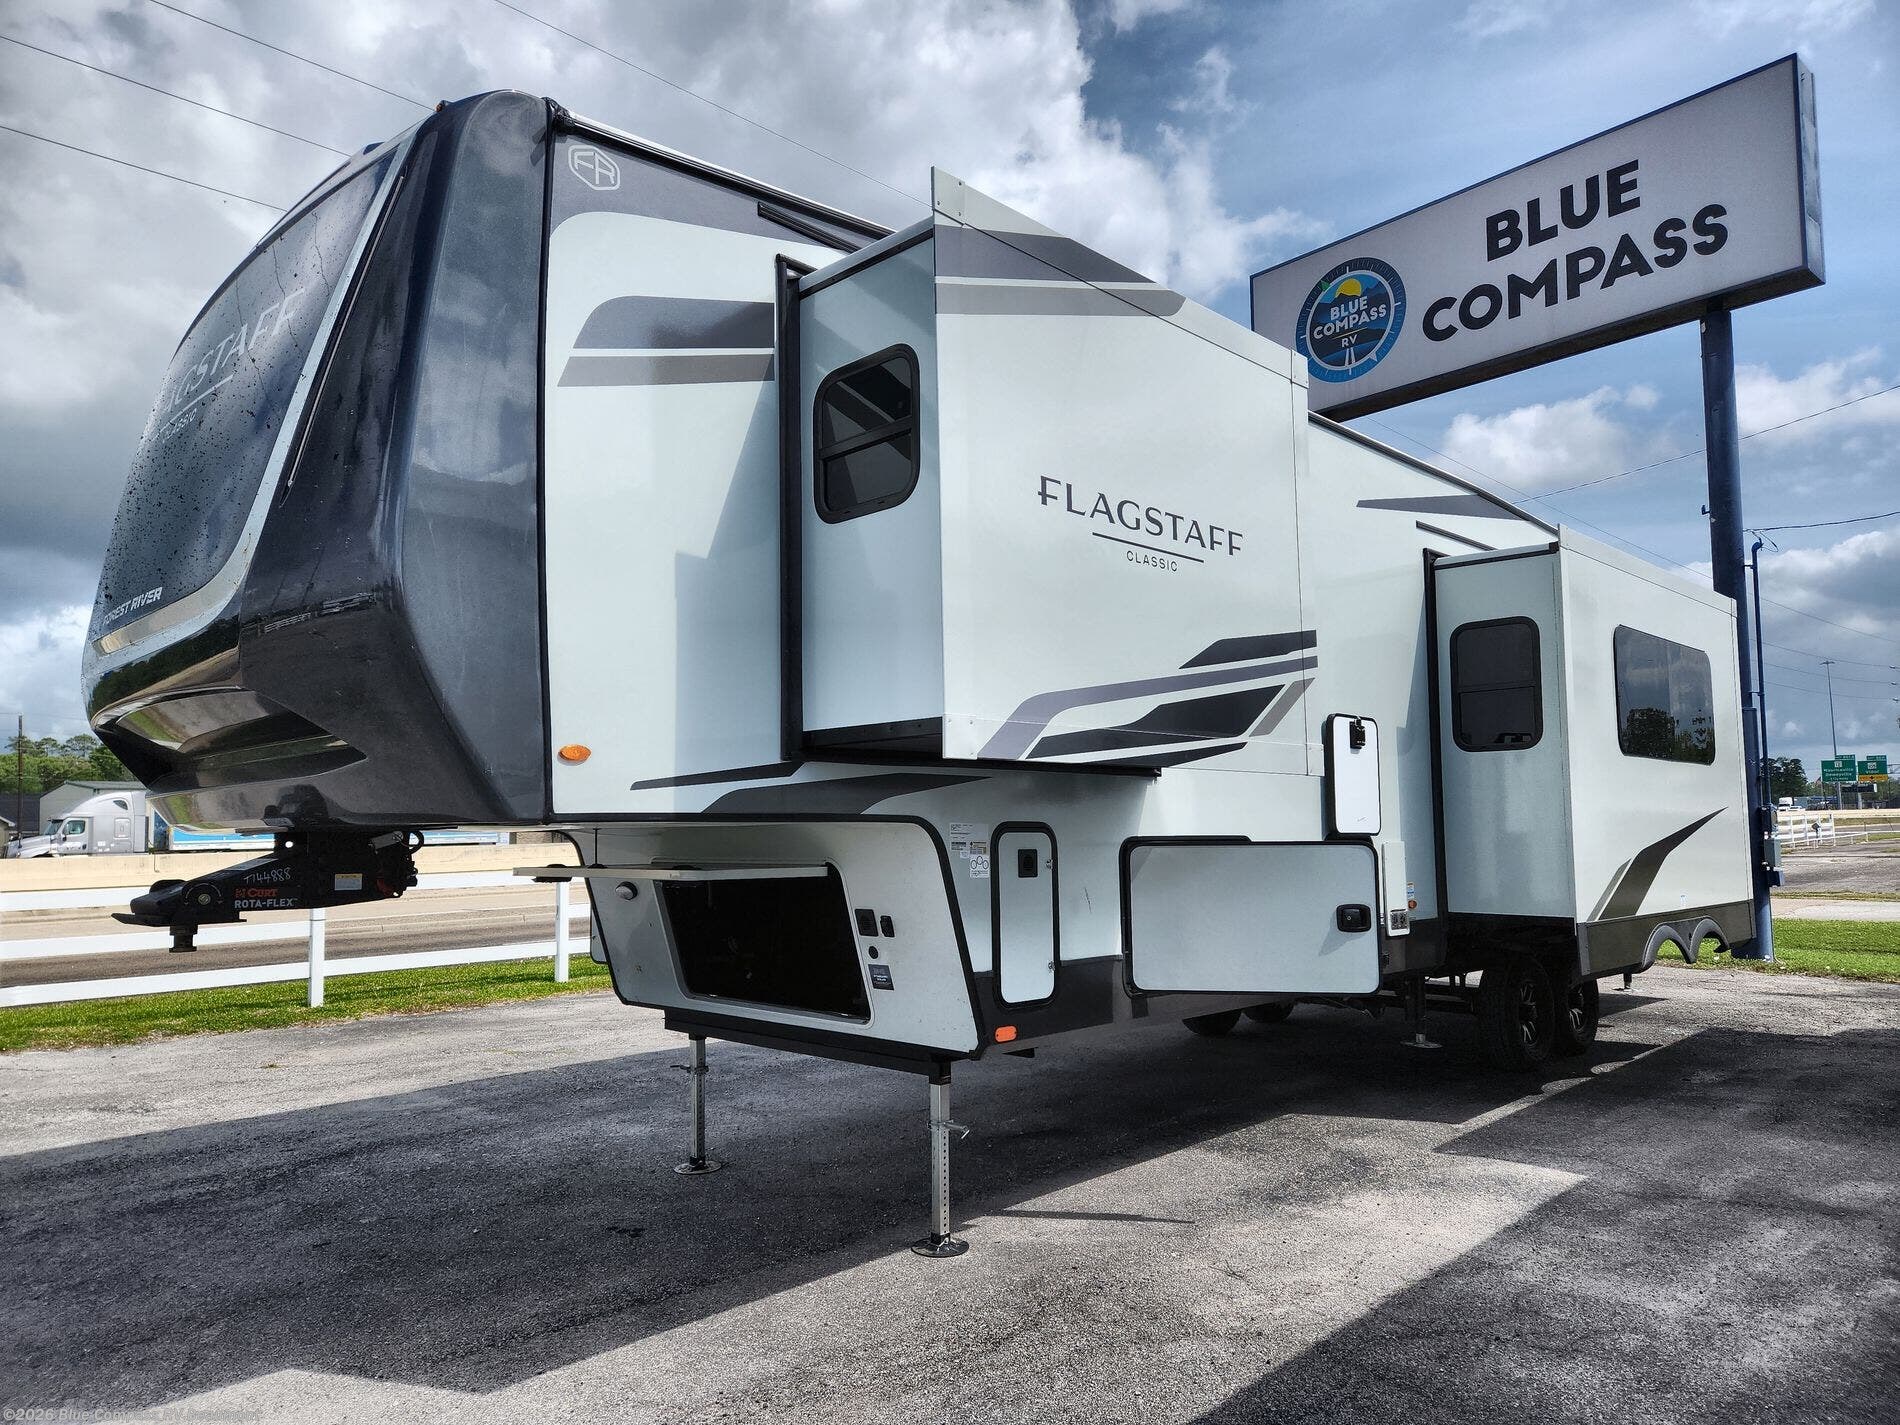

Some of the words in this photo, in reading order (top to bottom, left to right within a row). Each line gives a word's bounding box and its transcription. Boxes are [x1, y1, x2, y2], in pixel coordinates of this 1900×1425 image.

[1485, 159, 1642, 262] BLUE
[1422, 203, 1729, 342] COMPASS
[1330, 296, 1368, 320] BLUE
[1313, 303, 1387, 339] COMPASS
[1341, 334, 1358, 348] RV
[1037, 475, 1244, 556] FLAGSTAFF
[1126, 550, 1178, 572] CLASSIC
[130, 587, 163, 611] RIVER
[234, 898, 294, 909] ROTA-FLEX
